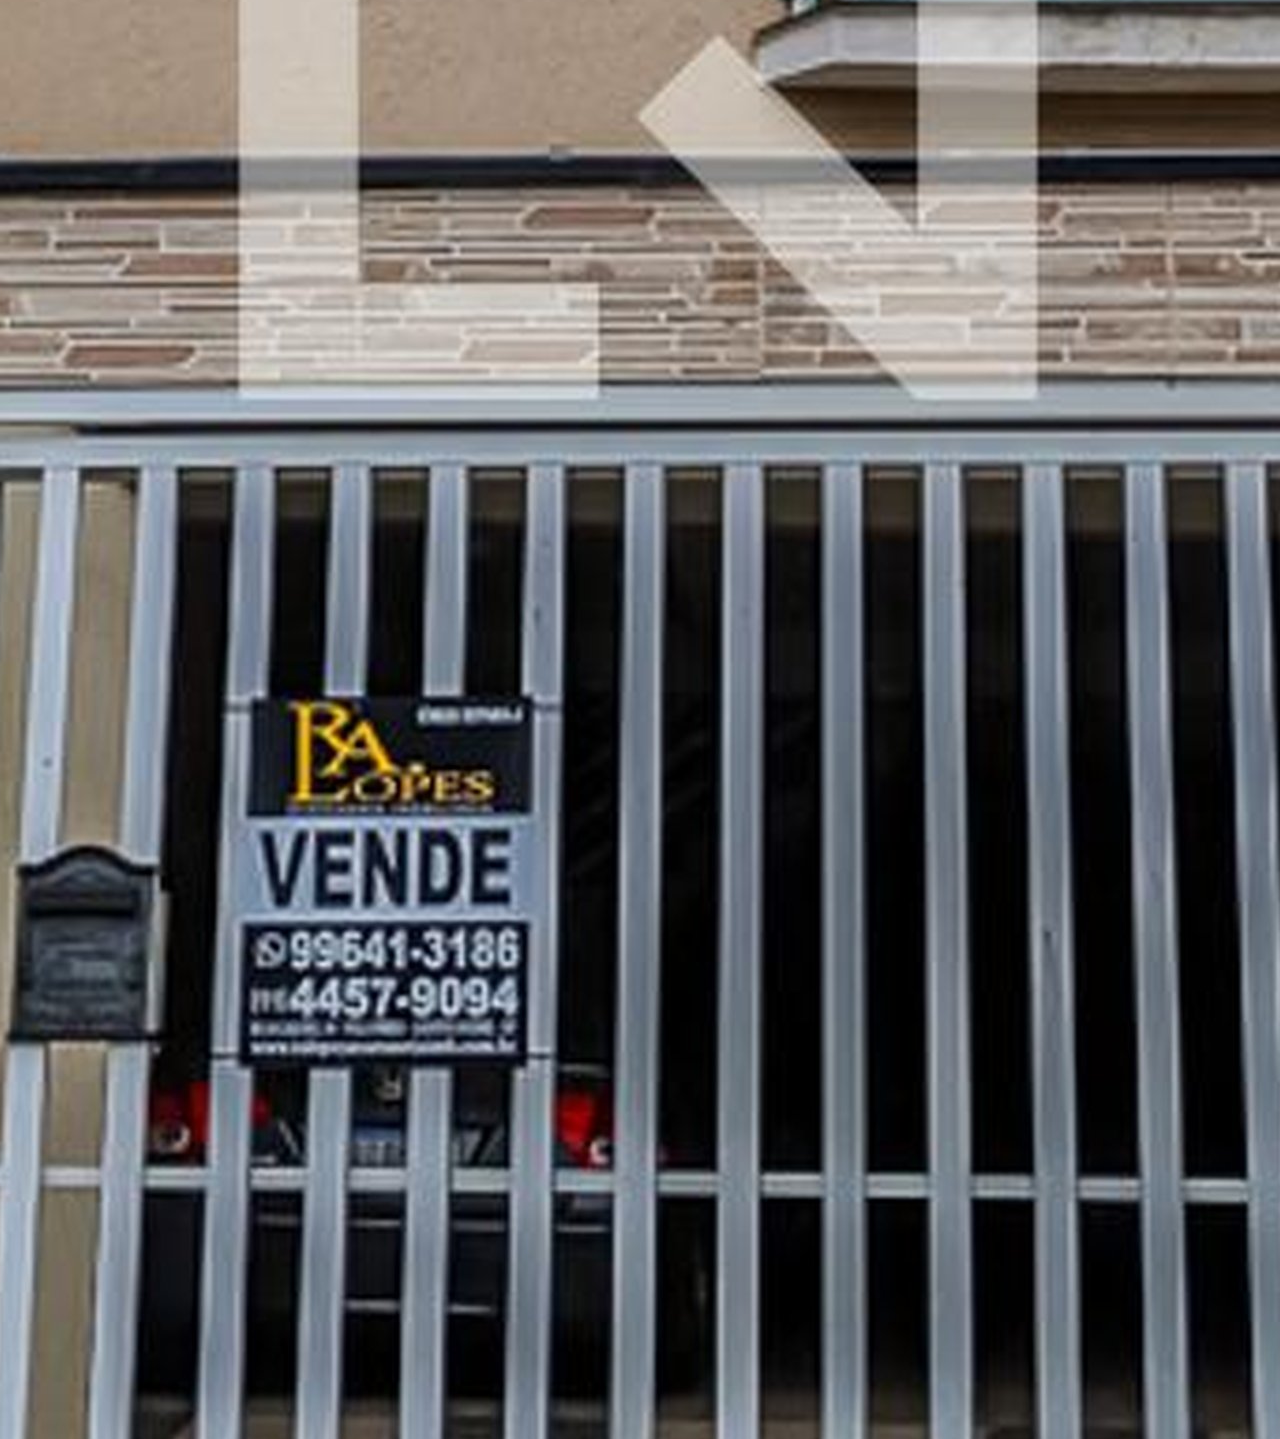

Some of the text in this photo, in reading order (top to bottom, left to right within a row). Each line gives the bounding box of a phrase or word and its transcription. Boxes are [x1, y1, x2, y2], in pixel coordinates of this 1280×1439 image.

[259, 827, 512, 907] VENDE
[290, 929, 520, 970] 99641-3186
[289, 978, 520, 1019] 4457-9094
